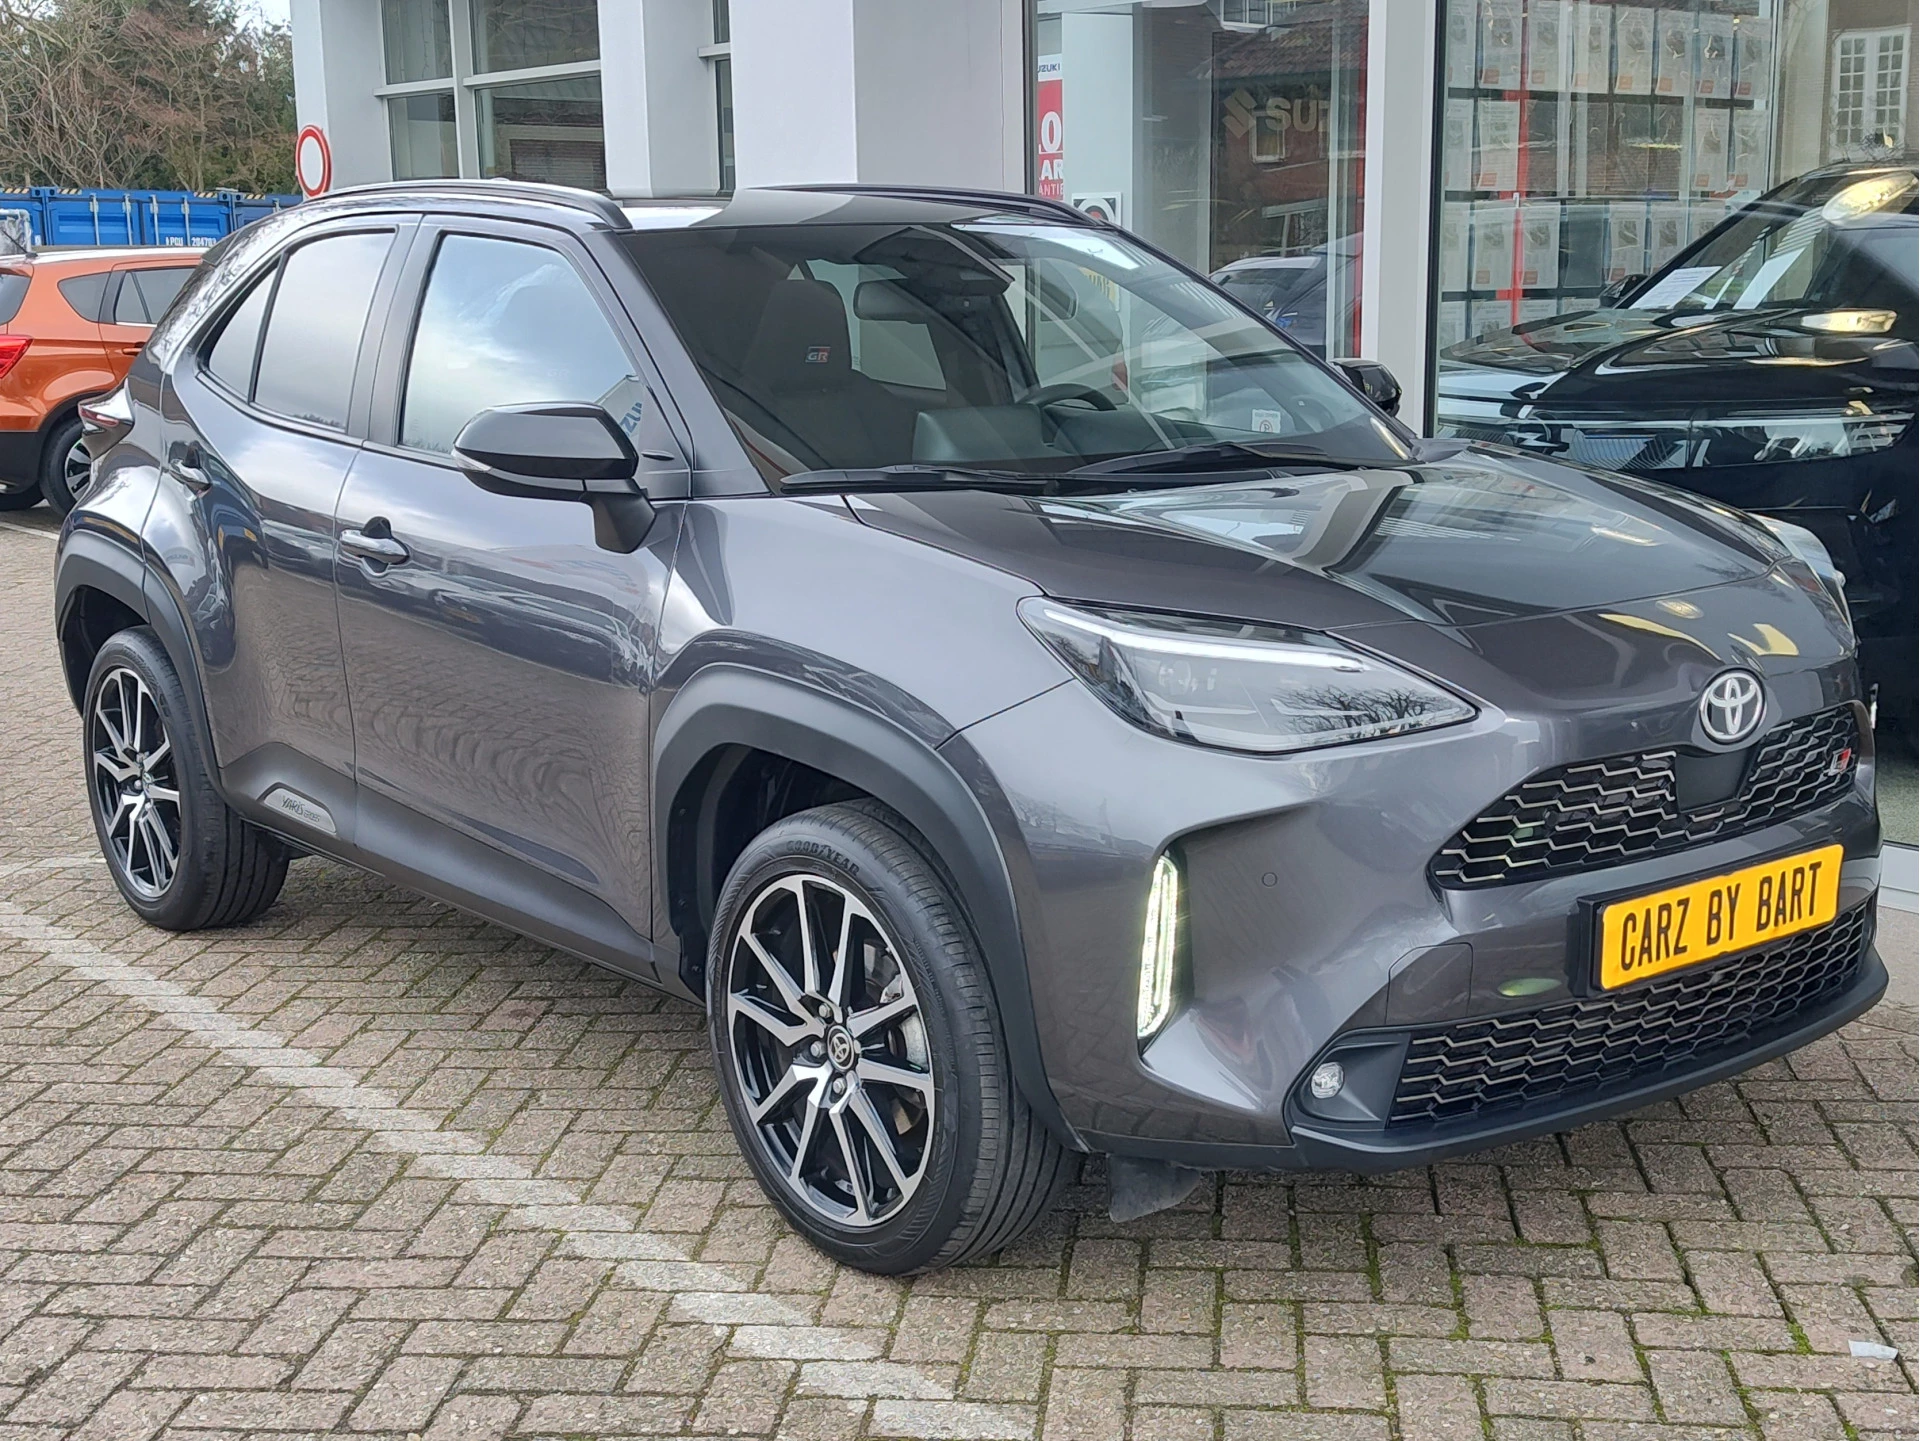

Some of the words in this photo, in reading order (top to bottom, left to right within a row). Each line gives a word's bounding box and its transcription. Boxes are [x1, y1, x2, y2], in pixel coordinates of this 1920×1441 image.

[1039, 158, 1064, 180] AR
[786, 840, 860, 877] GOODYEAR
[1620, 896, 1691, 971] CARZ
[1706, 882, 1741, 946] BY
[1756, 861, 1823, 932] BART
